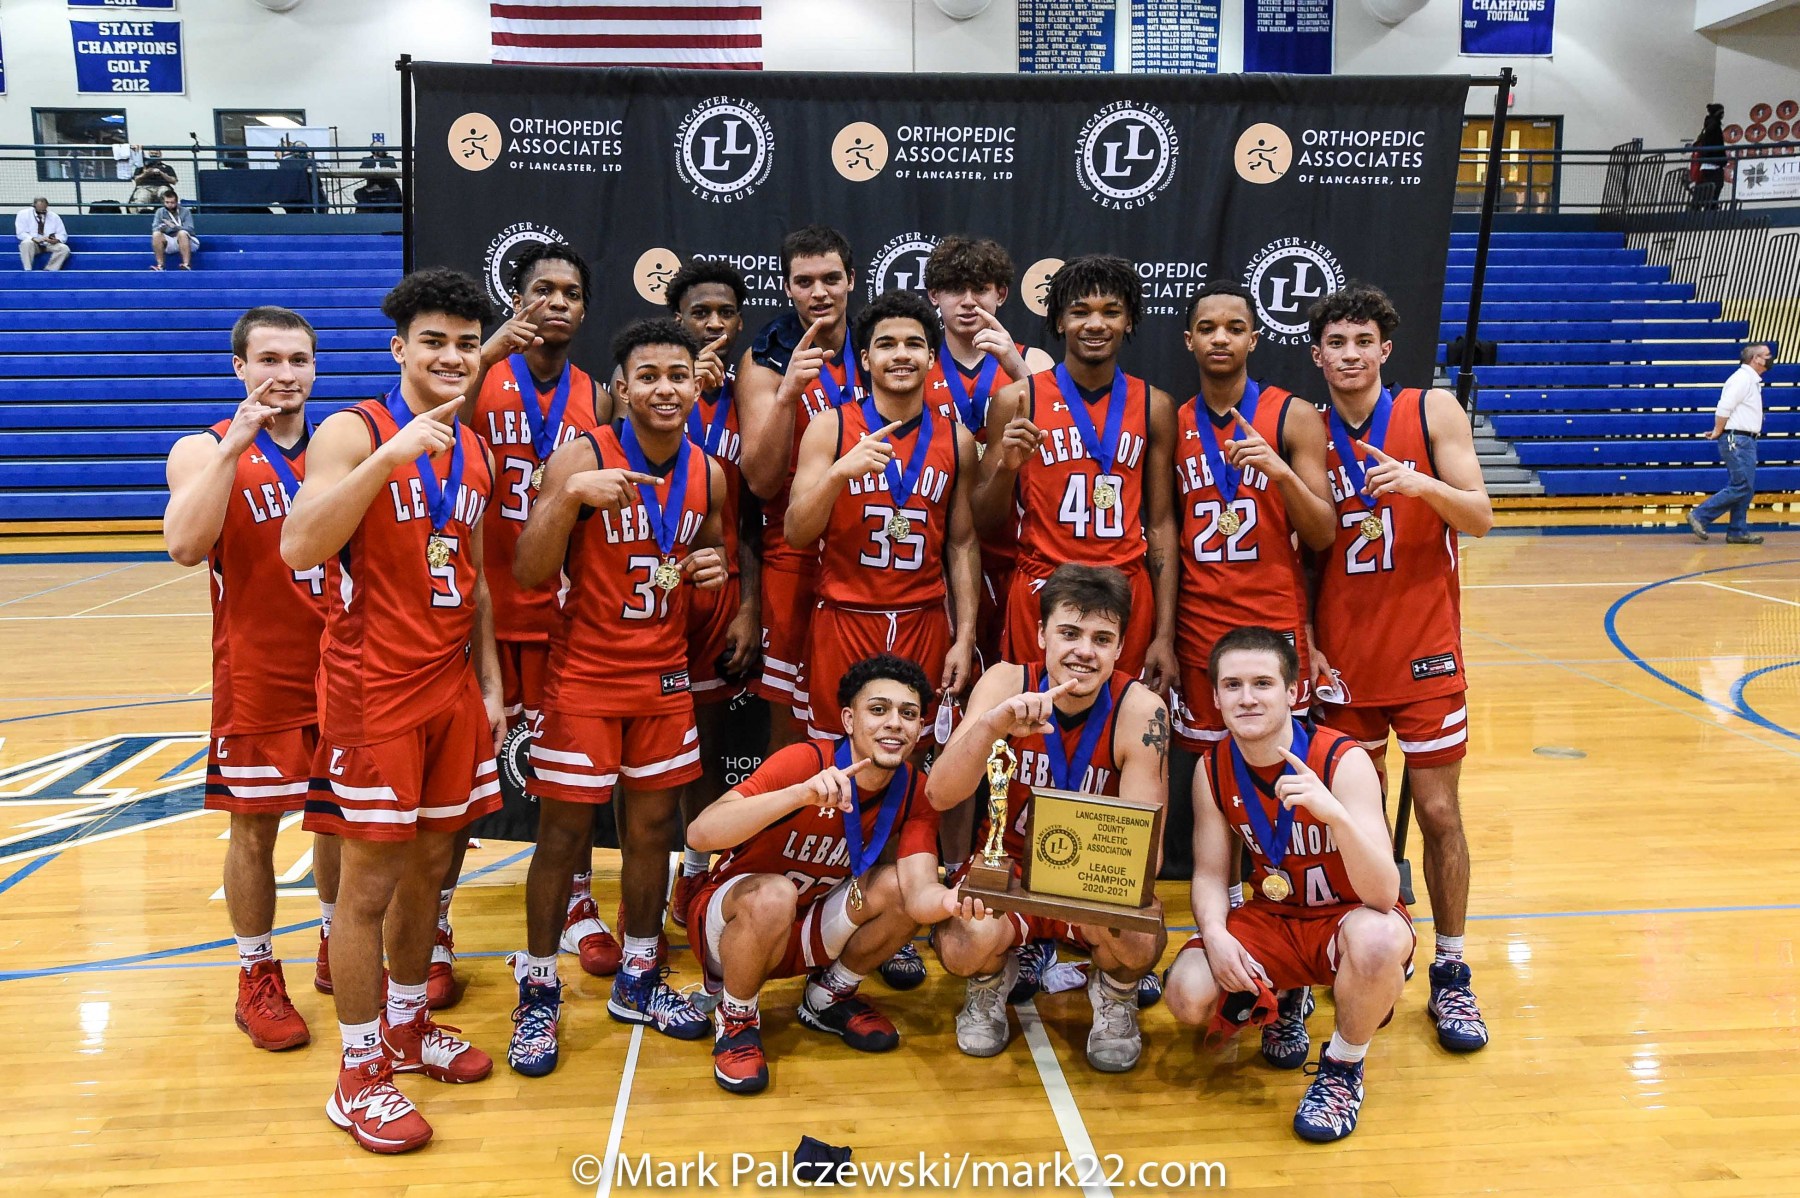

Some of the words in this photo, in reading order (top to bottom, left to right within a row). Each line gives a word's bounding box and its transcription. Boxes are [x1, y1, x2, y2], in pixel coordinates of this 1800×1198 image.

[1473, 0, 1544, 10] CHAMPIONS
[1487, 10, 1529, 21] FOOTBALL
[99, 23, 154, 36] STATE
[78, 41, 177, 55] CHAMPIONS
[108, 60, 151, 73] GOLF
[112, 79, 149, 92] 2012
[509, 118, 622, 136] ORTHOPEDIC
[673, 95, 729, 148] LANCASTER
[739, 98, 775, 151] LEBANON
[1075, 100, 1132, 155] LANCASTER
[1143, 101, 1179, 155] LEBANON
[898, 126, 1016, 143] ORTHOPEDIC
[1302, 129, 1425, 147] ORTHOPEDIC
[508, 139, 622, 156] ASSOCIATES
[895, 147, 1014, 163] ASSOCIATES
[510, 161, 524, 169] OF
[529, 162, 597, 172] LANCASTER,
[603, 163, 622, 172] LTD
[1298, 151, 1423, 168] ASSOCIATES
[896, 170, 910, 179] OF
[916, 171, 987, 181] LANCASTER,
[993, 171, 1013, 180] LTD
[1298, 175, 1315, 183] OF
[1320, 175, 1394, 185] LANCASTER,
[1400, 176, 1421, 185] LTD
[691, 185, 755, 204] LEAGUE
[1091, 191, 1157, 210] LEAGUE
[483, 221, 533, 271] LANCASTER
[866, 232, 921, 284] LANCASTER
[1241, 237, 1300, 288] LANCASTER
[1258, 325, 1311, 345] LEAGU
[1059, 474, 1124, 538] 40
[860, 505, 928, 571] 35
[1194, 499, 1257, 562] 22
[1342, 507, 1393, 574] 21
[429, 535, 462, 607] 5
[501, 722, 529, 758] LANCAST
[1076, 810, 1149, 827] LANCASTER-LEBANON
[1098, 824, 1125, 834] COUNTY
[1092, 834, 1128, 845] ATHLETIC
[1087, 844, 1132, 856] ASSOCIATION
[1090, 863, 1126, 875] LEAGUE
[1078, 872, 1136, 887] CHAMPION
[1083, 883, 1128, 896] 2020-2021
[532, 967, 549, 977] 31
[363, 1034, 376, 1046] 5
